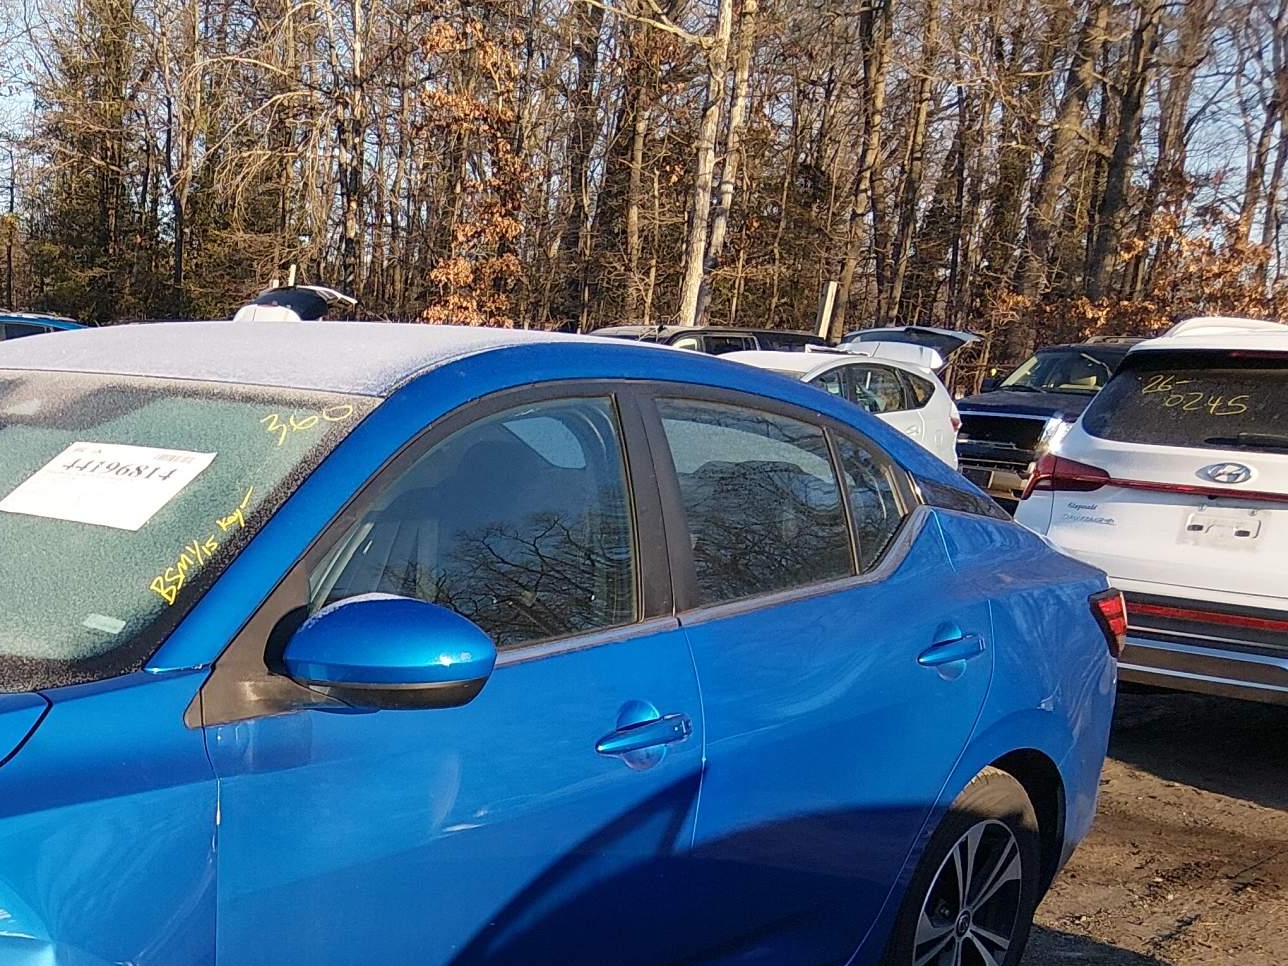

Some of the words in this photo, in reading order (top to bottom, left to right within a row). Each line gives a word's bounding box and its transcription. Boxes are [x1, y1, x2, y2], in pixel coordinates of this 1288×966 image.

[1165, 392, 1250, 416] 0245
[259, 404, 353, 447] 360
[62, 458, 178, 481] 44196814
